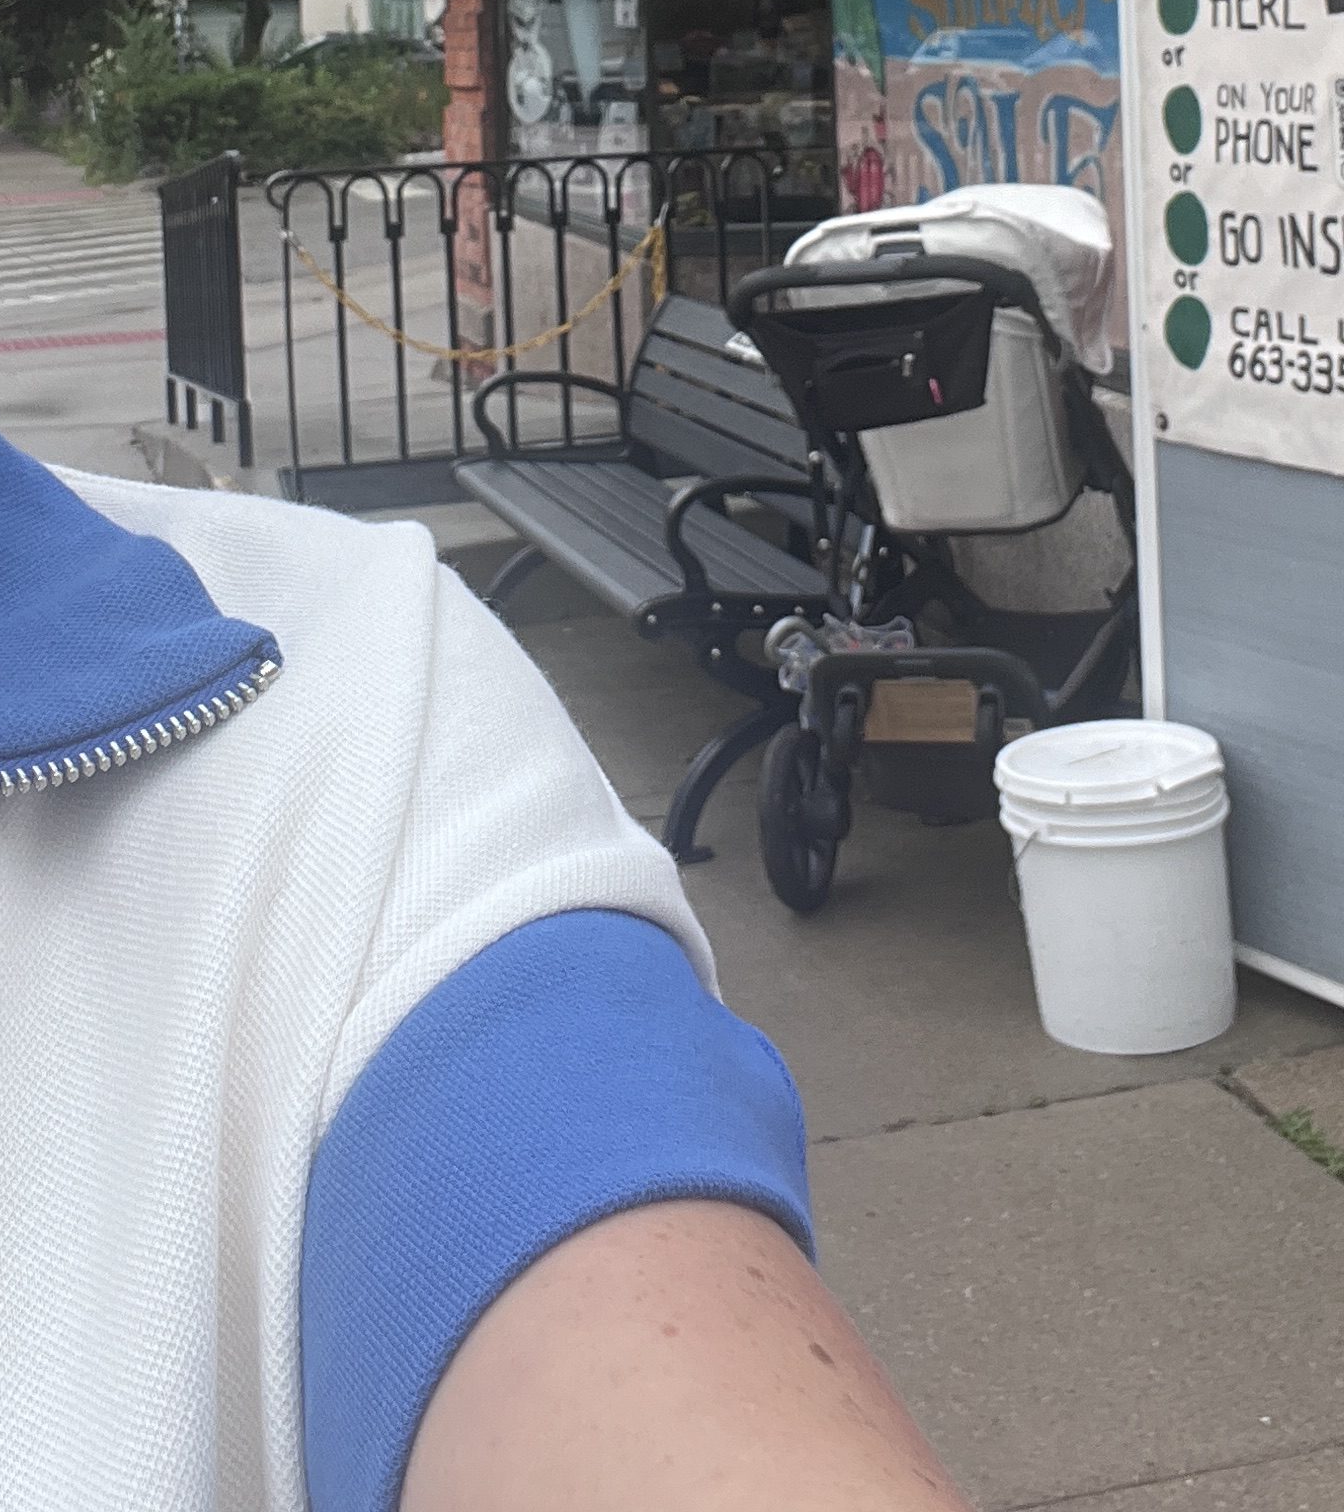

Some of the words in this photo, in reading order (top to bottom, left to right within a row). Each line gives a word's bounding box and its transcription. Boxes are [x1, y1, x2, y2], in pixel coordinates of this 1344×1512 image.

[1161, 45, 1186, 69] or
[1216, 82, 1248, 111] ON
[1259, 83, 1317, 115] YOUR
[1214, 117, 1319, 173] PHONE
[1169, 159, 1194, 186] or
[1219, 210, 1264, 268] GO
[1174, 268, 1200, 290] or
[1230, 306, 1319, 347] CALL
